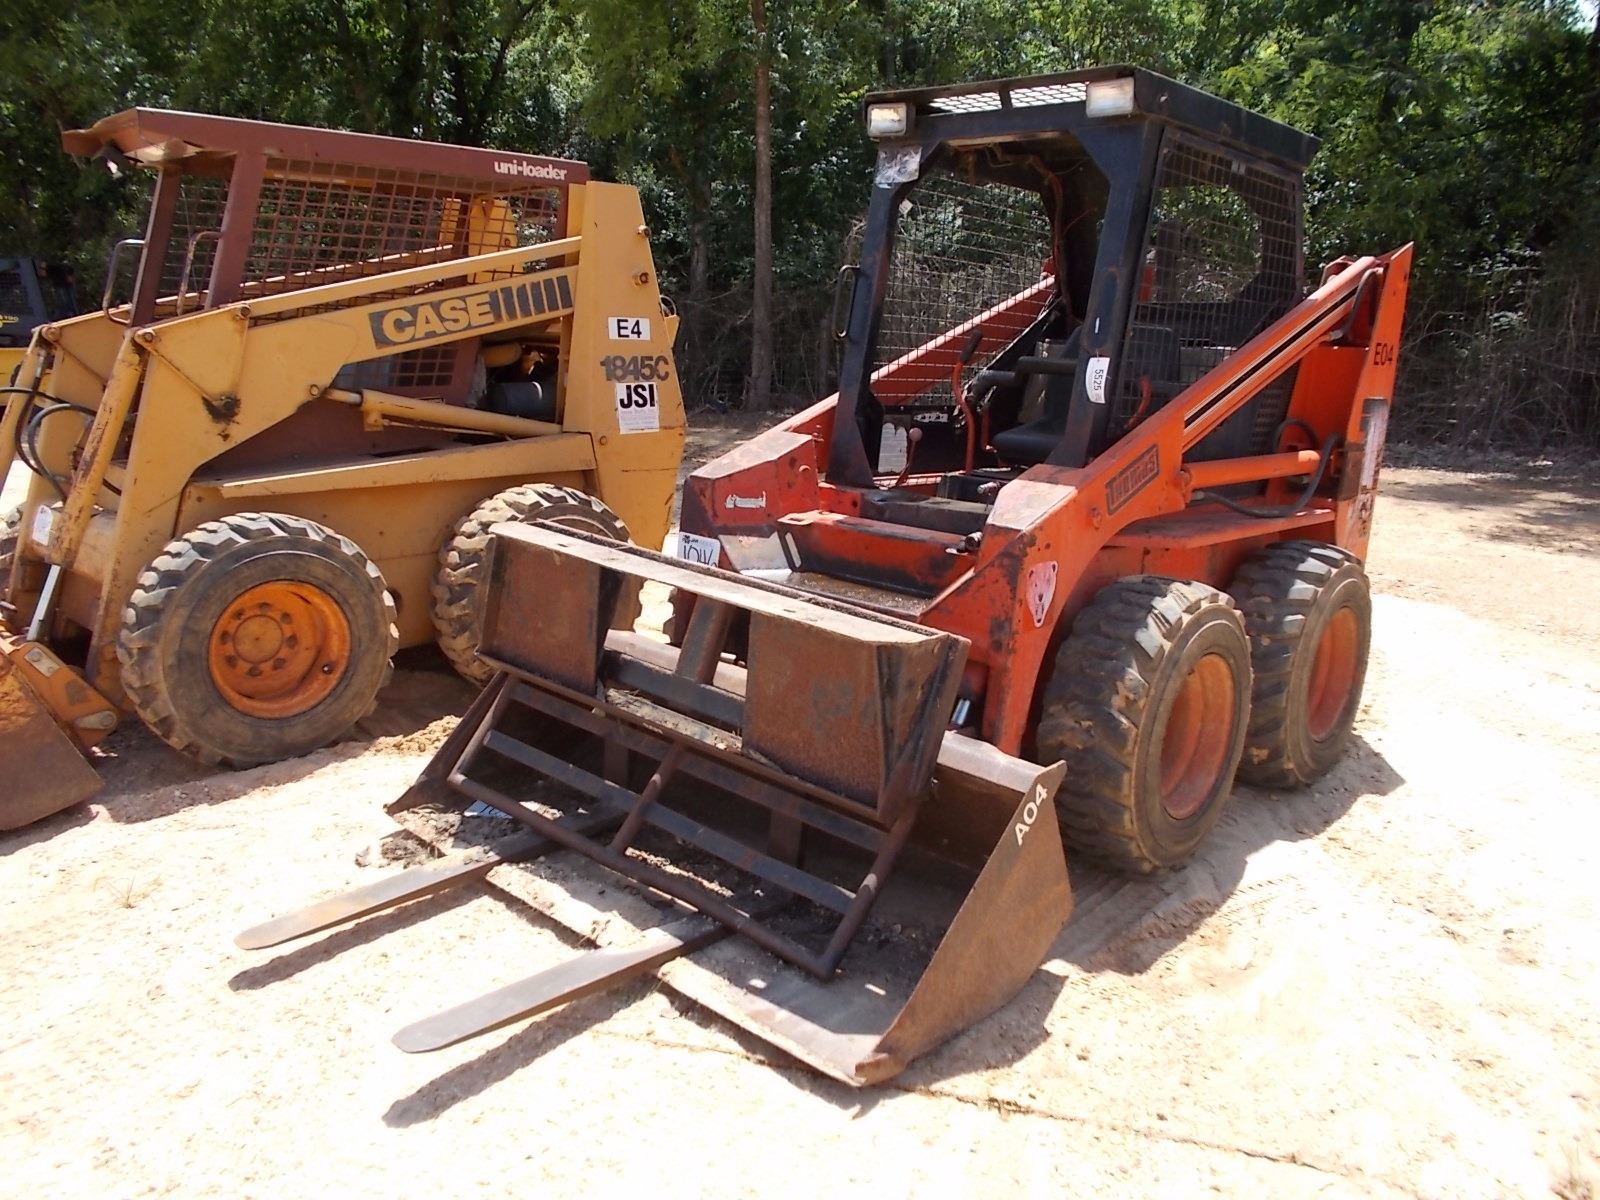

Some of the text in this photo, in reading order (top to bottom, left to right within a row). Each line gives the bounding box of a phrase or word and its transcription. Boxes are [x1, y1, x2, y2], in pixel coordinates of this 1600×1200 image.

[494, 160, 567, 180] uni-loader
[382, 293, 495, 343] CASE
[616, 318, 642, 339] E4
[600, 355, 670, 381] 1845C
[1093, 369, 1104, 391] 5525
[619, 384, 655, 409] JSI
